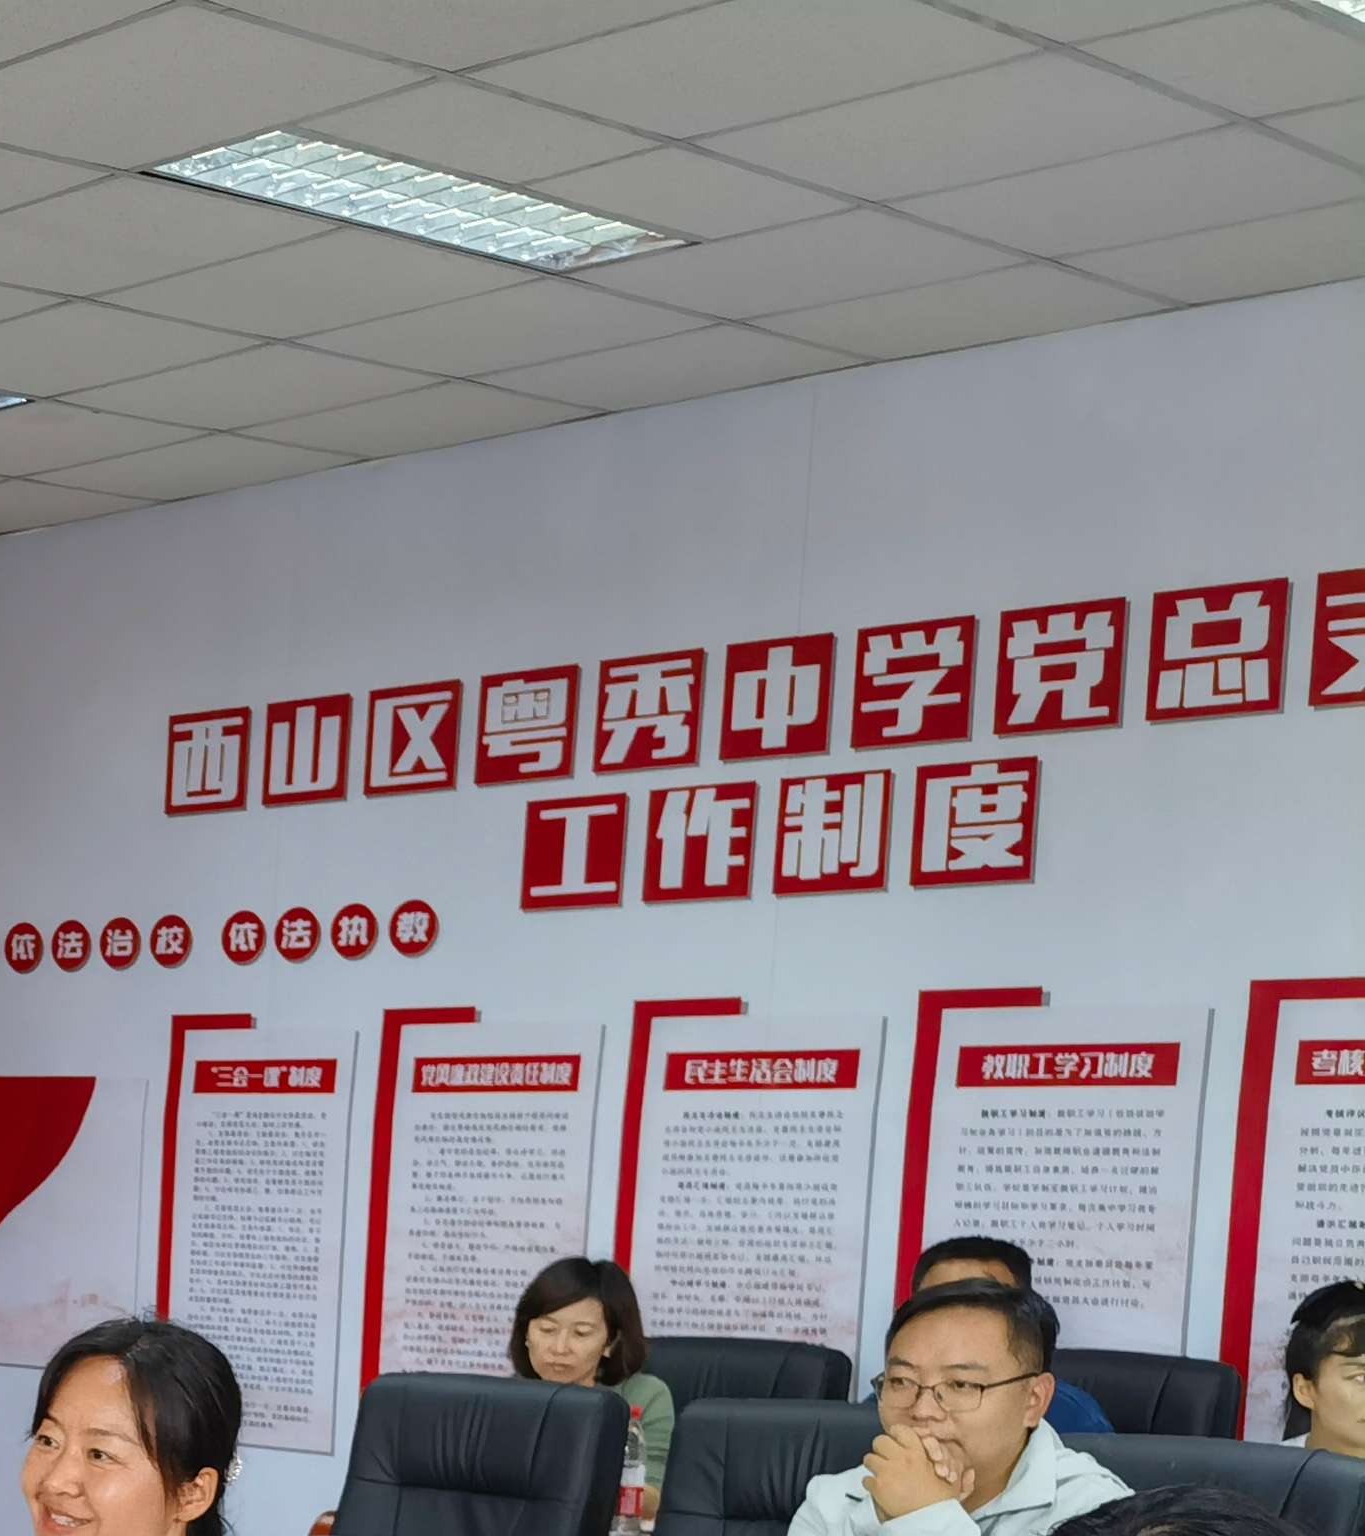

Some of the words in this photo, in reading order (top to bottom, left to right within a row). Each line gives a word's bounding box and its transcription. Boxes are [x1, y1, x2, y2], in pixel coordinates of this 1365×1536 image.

[527, 760, 1033, 900] 工作制度
[11, 925, 185, 961] 依法治校
[228, 911, 429, 952] 依法执教
[684, 1058, 839, 1085] 民主生活会制度
[981, 1051, 1155, 1080] 教职工学习制度
